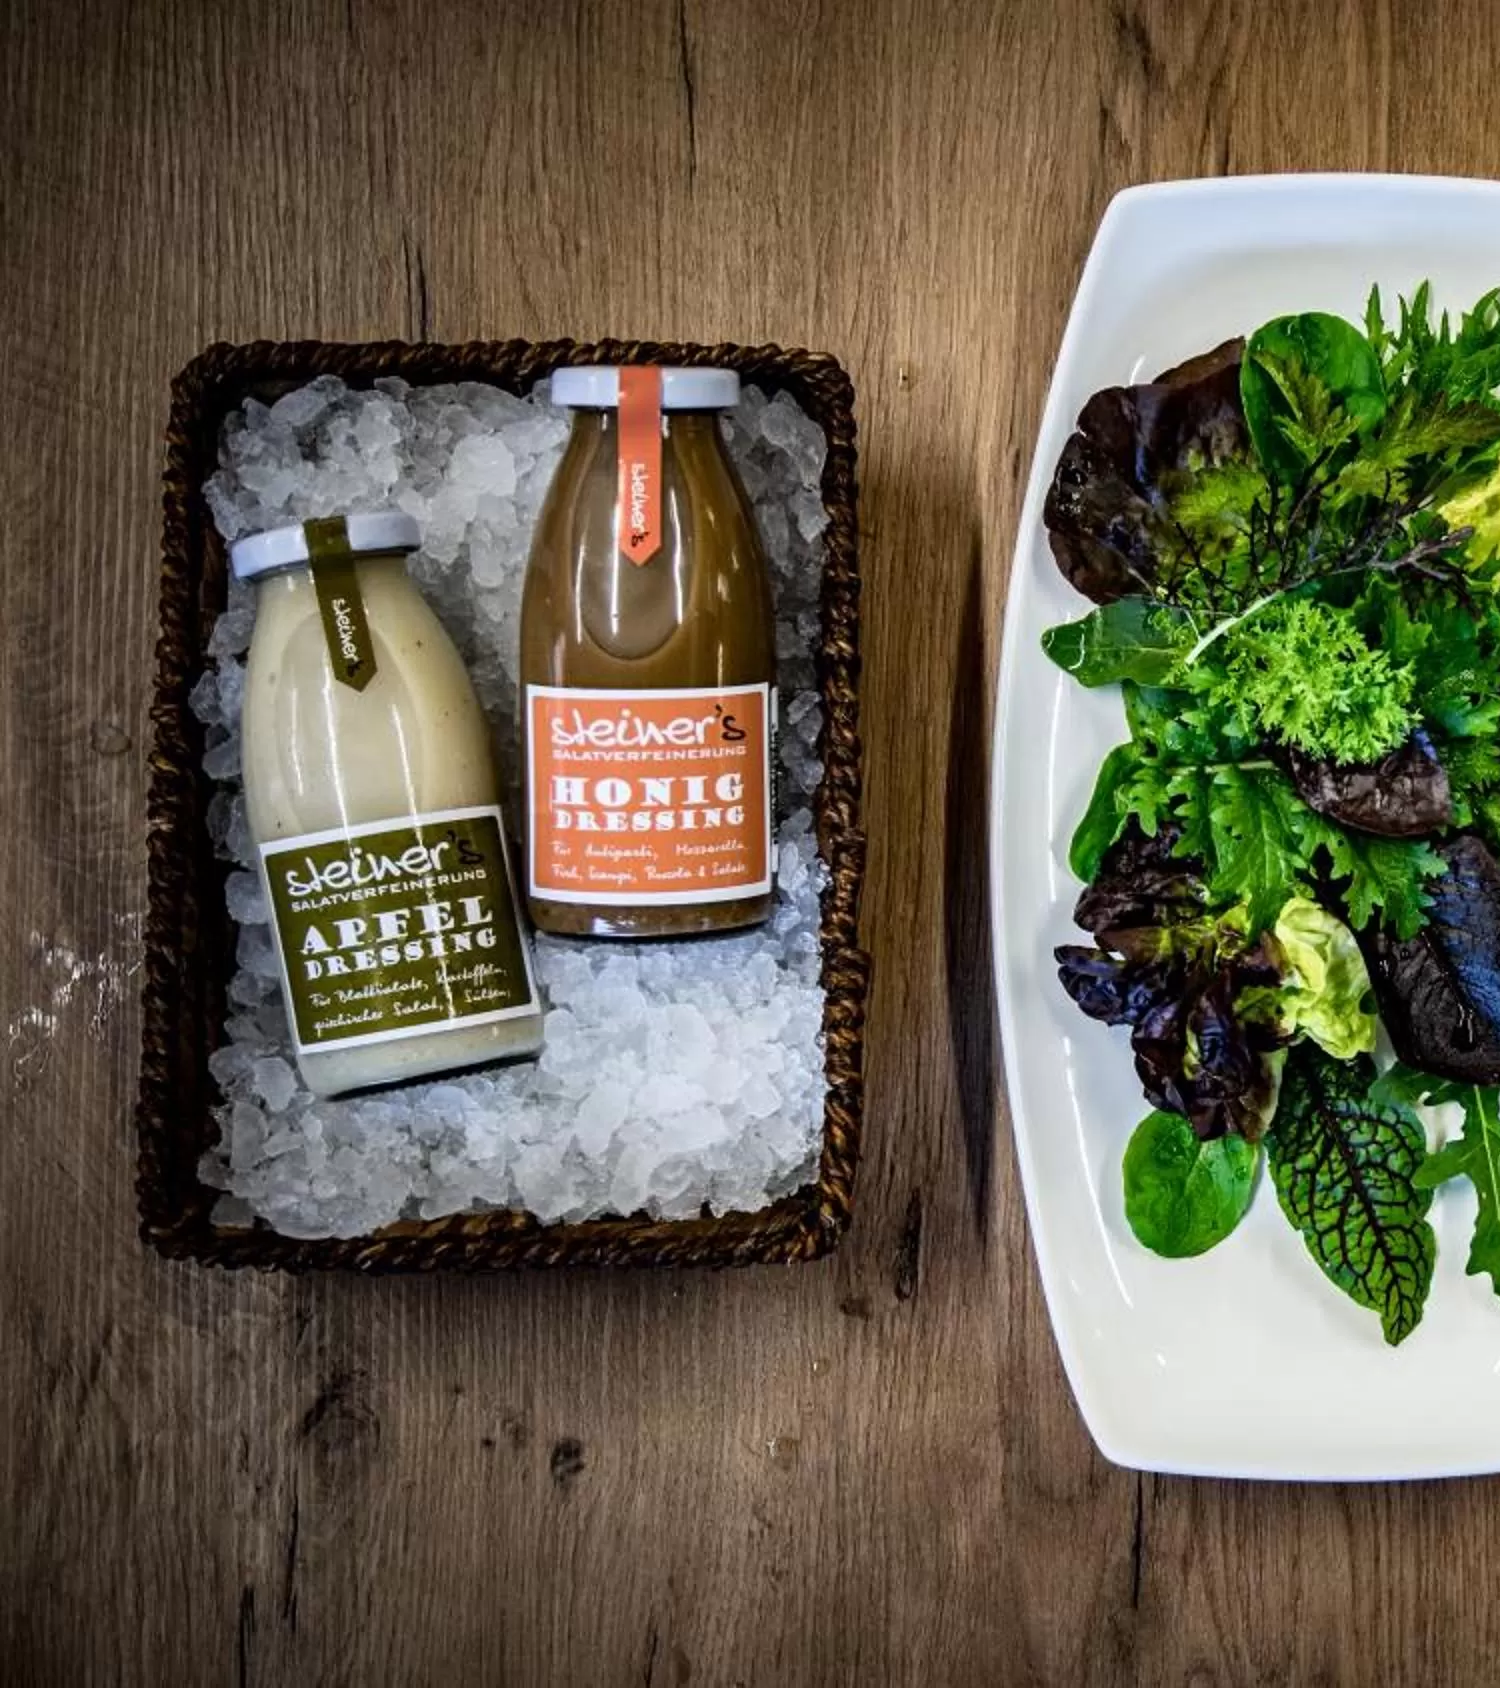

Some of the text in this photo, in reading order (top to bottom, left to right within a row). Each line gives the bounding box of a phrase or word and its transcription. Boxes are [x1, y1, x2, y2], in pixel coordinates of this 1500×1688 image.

[552, 703, 747, 747] steiner's
[552, 746, 748, 762] SALATVERFEINERUNG
[551, 773, 745, 807] HONIG
[555, 805, 745, 833] DRESSING
[286, 829, 485, 897] steiner's
[291, 868, 487, 913] SALATVERFEINERUNG
[300, 895, 494, 955] APFEL
[303, 927, 498, 981] DRESSING
